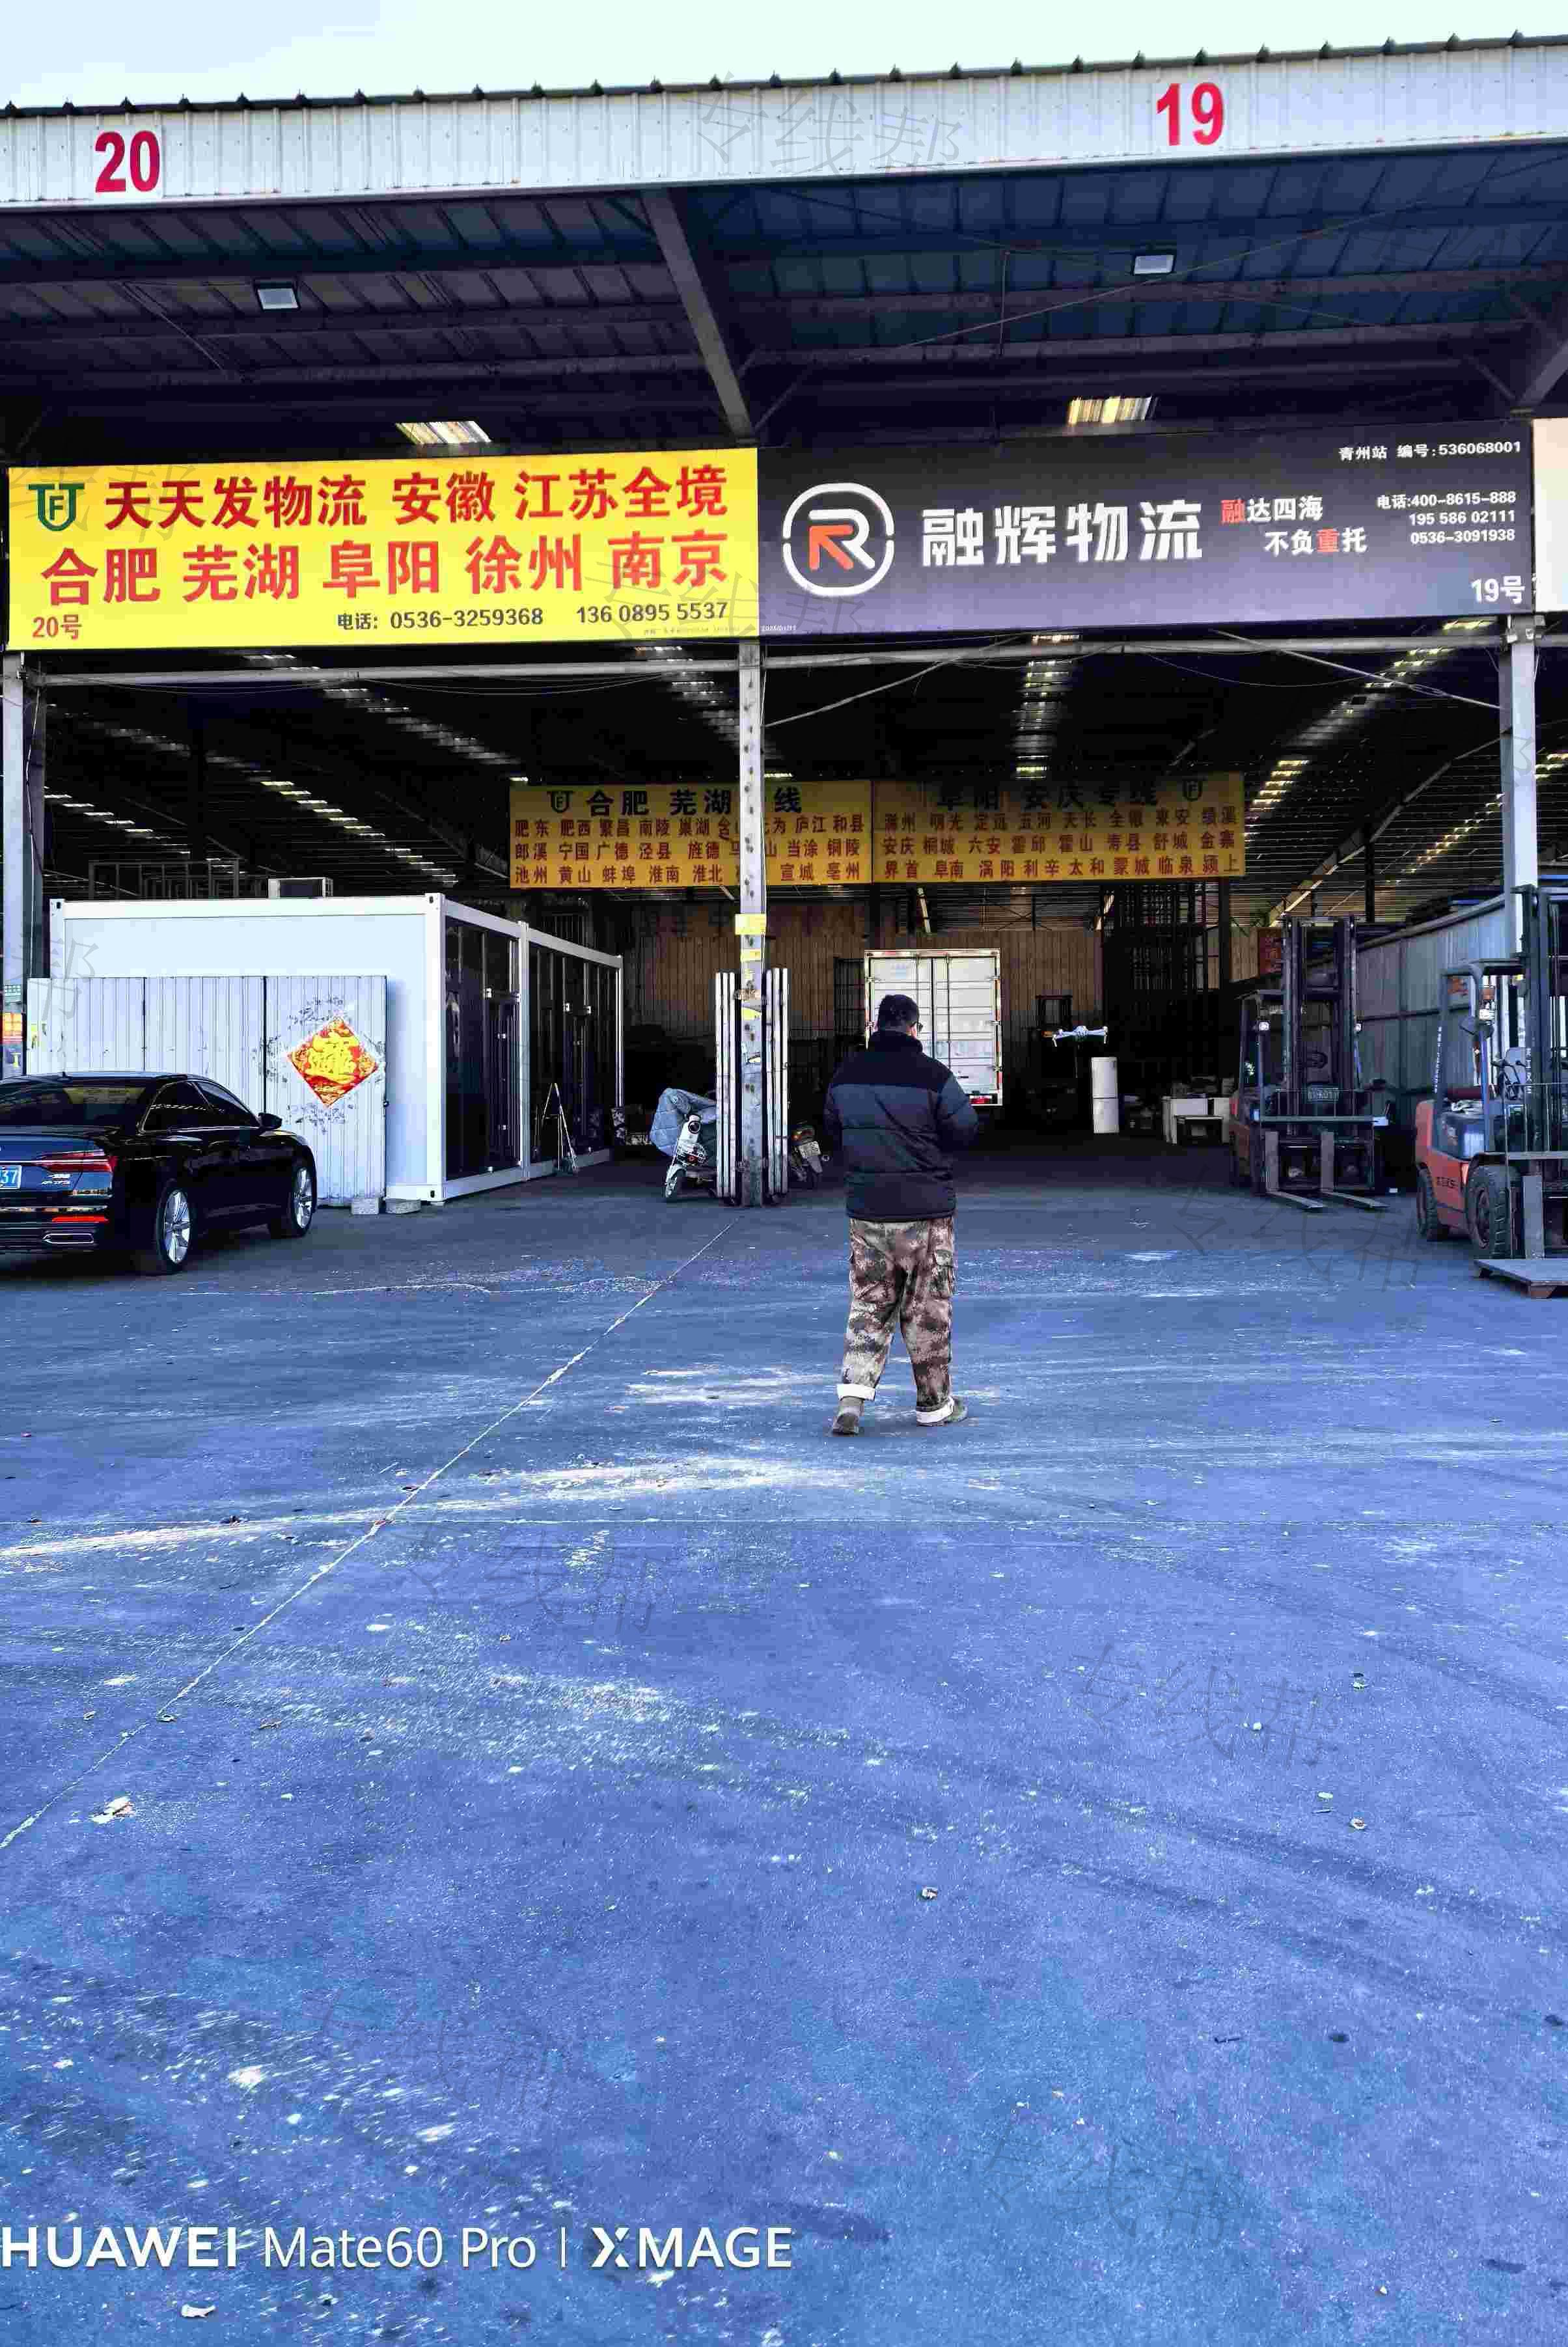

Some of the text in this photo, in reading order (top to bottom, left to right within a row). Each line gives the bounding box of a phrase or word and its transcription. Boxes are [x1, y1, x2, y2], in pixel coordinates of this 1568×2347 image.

[1157, 82, 1224, 146] 19
[95, 130, 160, 193] 20
[1338, 446, 1388, 461] 青州站
[104, 464, 728, 530] 天天发物流 安徽 江苏全境
[1220, 495, 1324, 525] 融达四海
[1409, 510, 1515, 525] 195 586 02111
[921, 500, 1203, 567] 融辉物流
[1264, 527, 1369, 557] 不负重托
[1410, 529, 1515, 545] 0536-3091938
[41, 528, 728, 606] 合肥 芜湖 阜阳 徐州 南京
[1471, 575, 1525, 605] 19号
[32, 614, 83, 640] 20号
[390, 607, 543, 629] 0536-3259368
[576, 601, 728, 624] 136 0895 5537
[586, 789, 650, 817] 合肥
[773, 786, 803, 814] 线
[558, 864, 591, 884] 黄山
